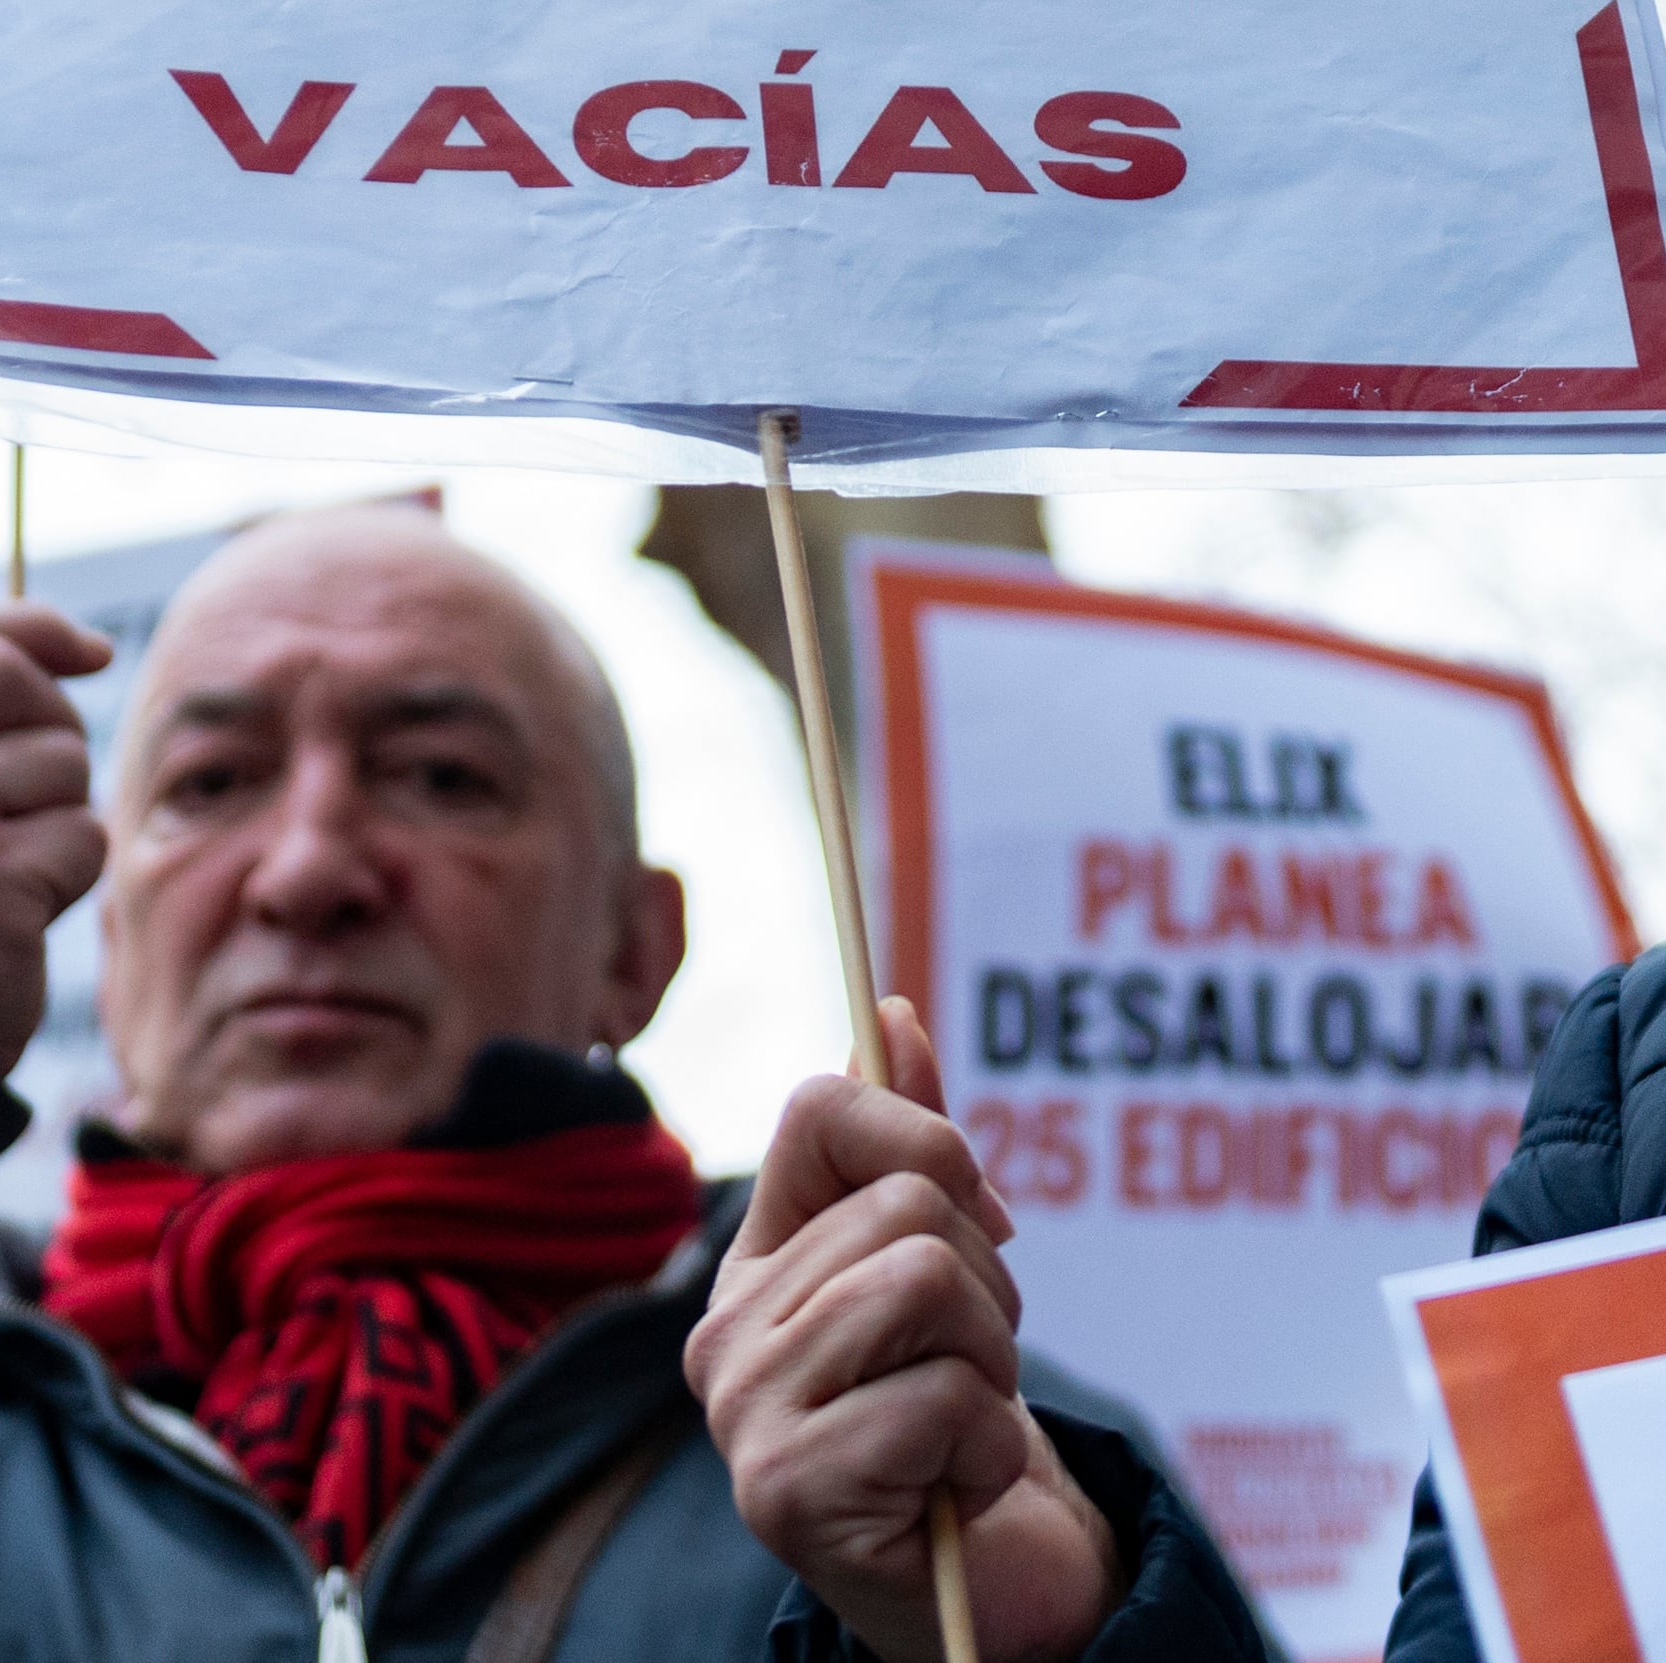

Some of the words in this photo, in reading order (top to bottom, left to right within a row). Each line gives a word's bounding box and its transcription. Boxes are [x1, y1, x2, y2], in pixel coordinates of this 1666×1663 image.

[167, 47, 1189, 202] VACÍAS
[1165, 725, 1363, 825] ELIX
[1075, 838, 1478, 953] PLANEA
[965, 1098, 1091, 1210] 25
